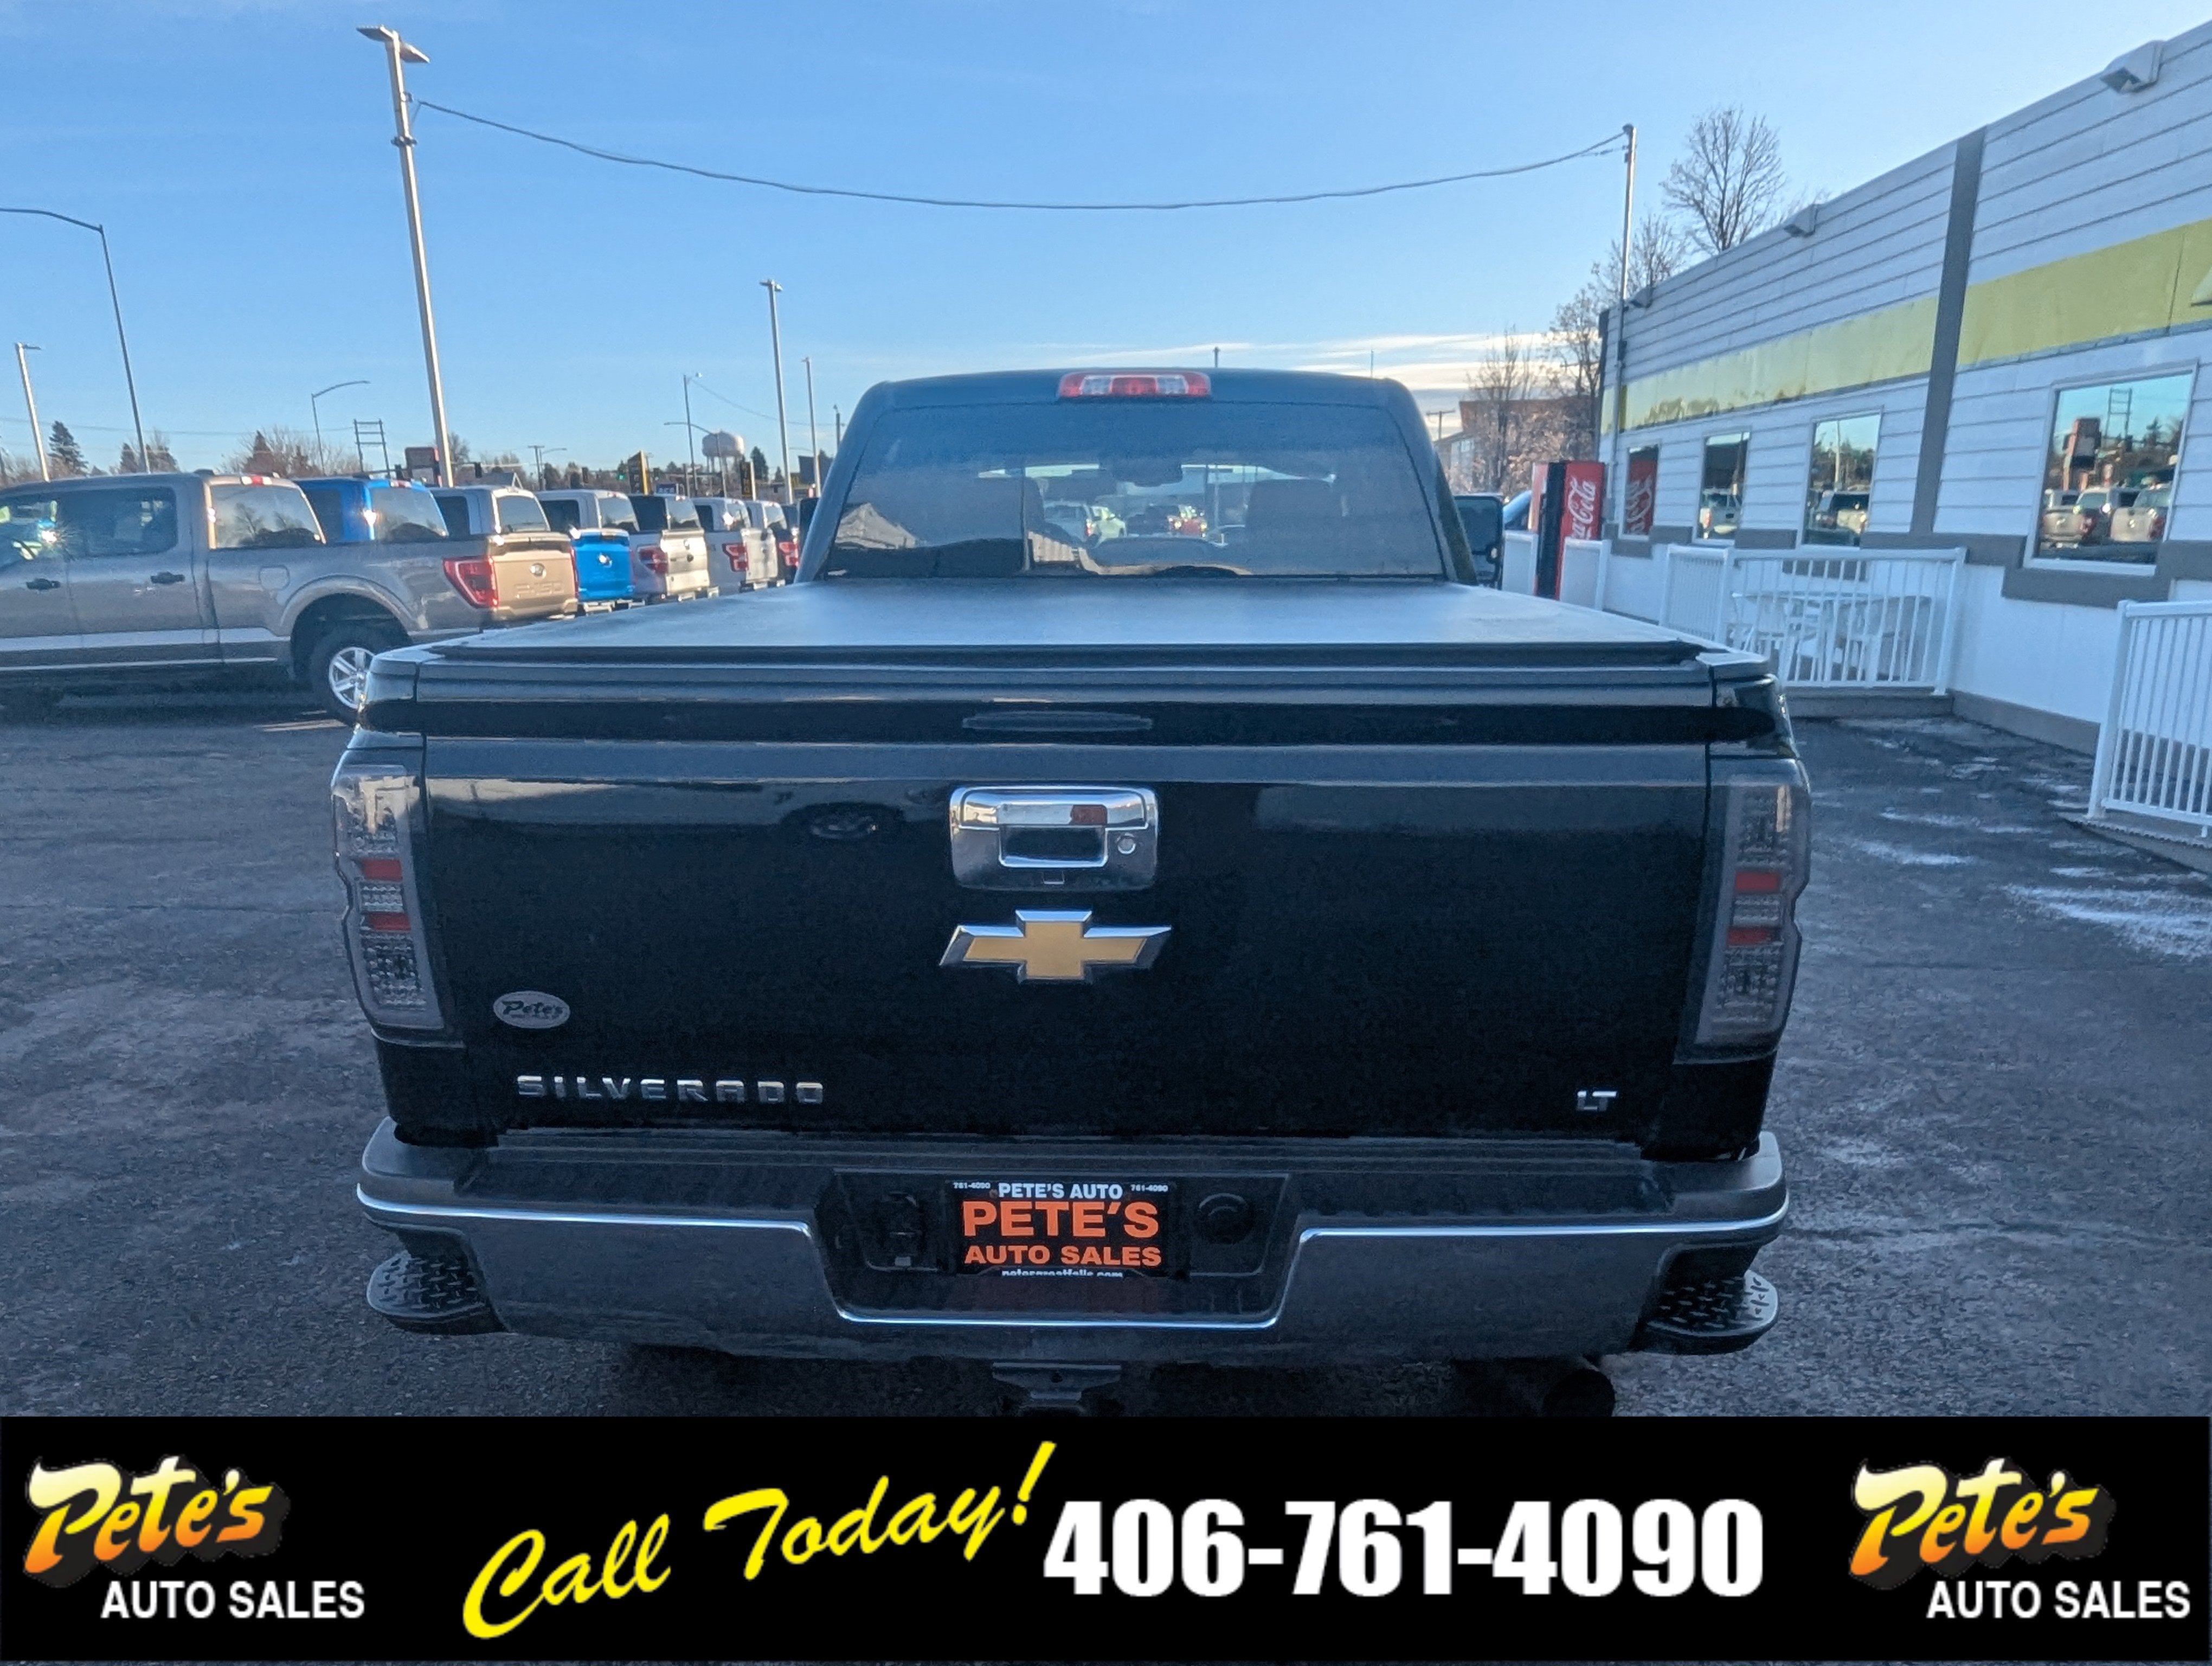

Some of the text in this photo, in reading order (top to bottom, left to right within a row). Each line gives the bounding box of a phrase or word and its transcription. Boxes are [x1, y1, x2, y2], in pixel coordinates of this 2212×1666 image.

[517, 1075, 824, 1104] SILVERADO
[1577, 1091, 1618, 1112] LT
[998, 1182, 1123, 1200] PETE'S AUTO
[962, 1201, 1159, 1239] PETE'S
[964, 1245, 1162, 1267] AUTO SALES
